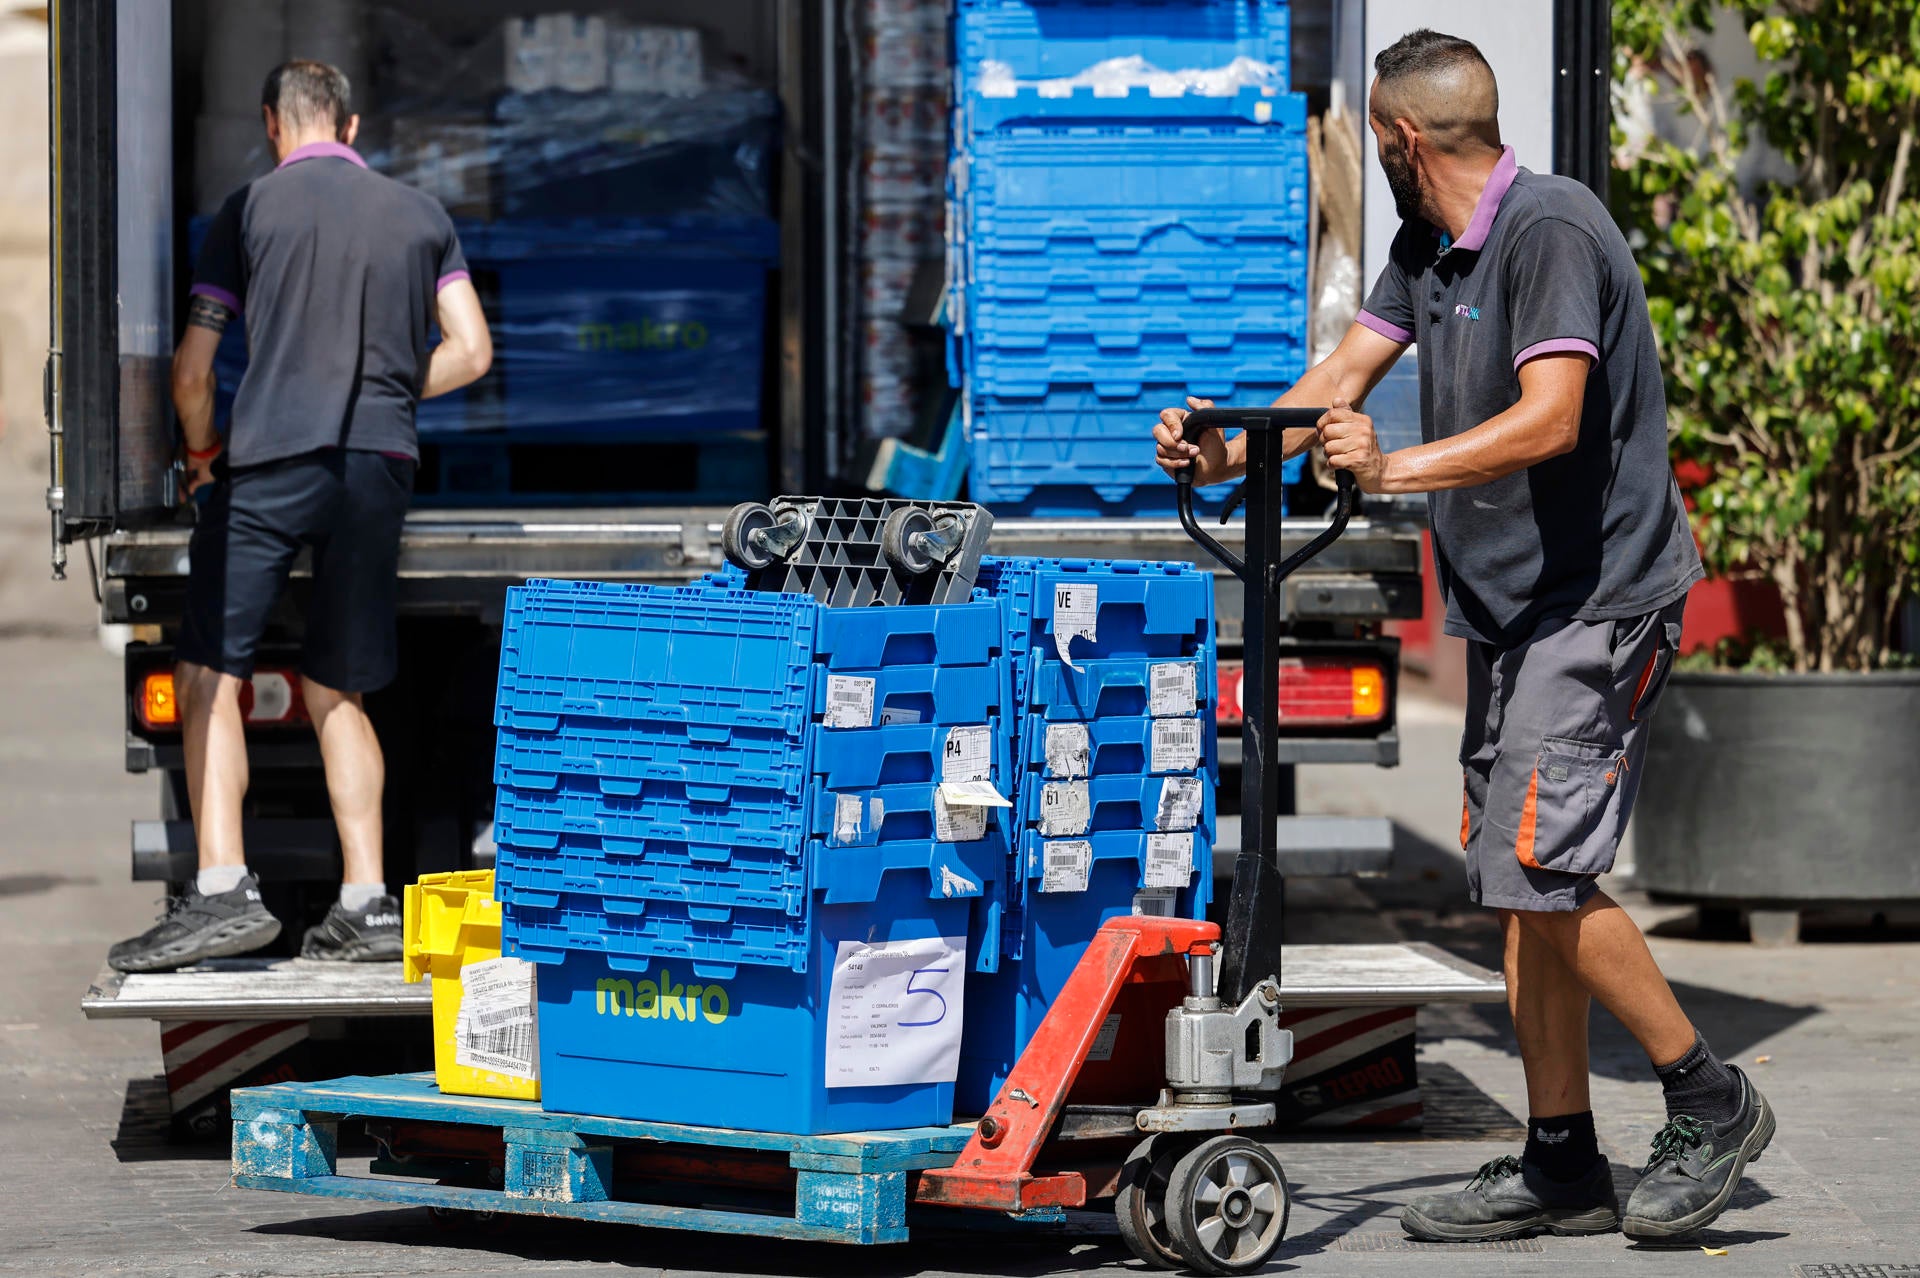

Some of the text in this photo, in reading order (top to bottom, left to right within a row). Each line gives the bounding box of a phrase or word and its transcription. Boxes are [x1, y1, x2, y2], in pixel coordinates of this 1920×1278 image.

[576, 314, 708, 351] makro
[1058, 591, 1071, 608] VE
[946, 740, 962, 758] P4
[1046, 790, 1059, 806] 61
[596, 969, 729, 1024] makro
[897, 968, 949, 1028] 5
[1323, 1057, 1404, 1101] ZEPRO
[816, 1200, 860, 1214] OF CHEP
